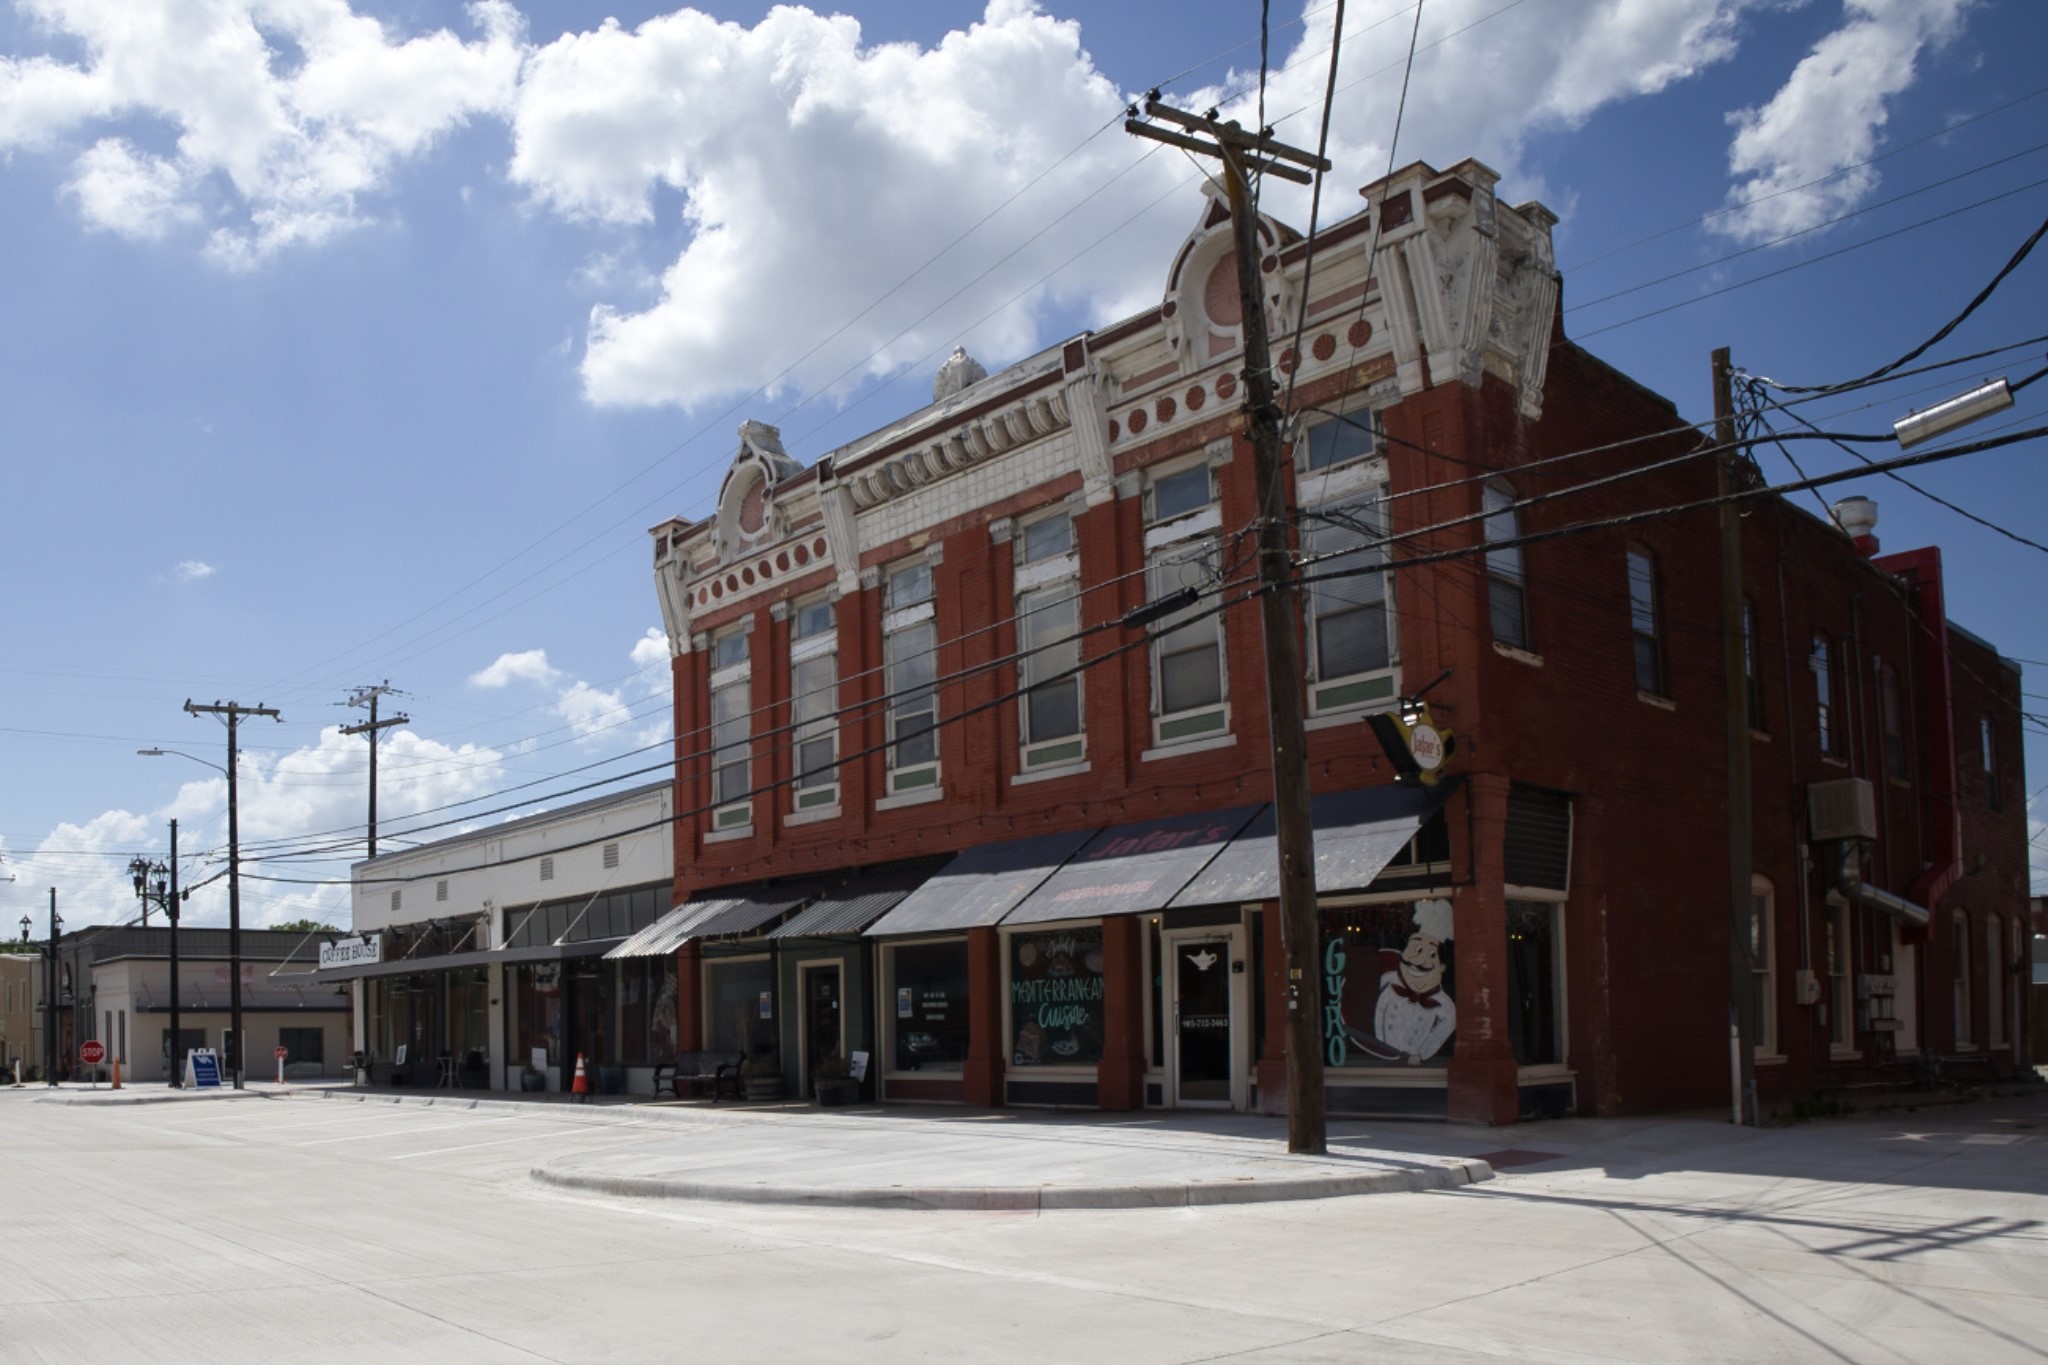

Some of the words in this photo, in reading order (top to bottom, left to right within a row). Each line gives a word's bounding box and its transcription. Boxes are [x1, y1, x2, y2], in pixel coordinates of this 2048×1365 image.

[1088, 824, 1229, 861] Jafar's
[352, 942, 377, 960] HOUSE
[1038, 1003, 1089, 1031] Cuisine
[82, 1046, 103, 1056] STOP
